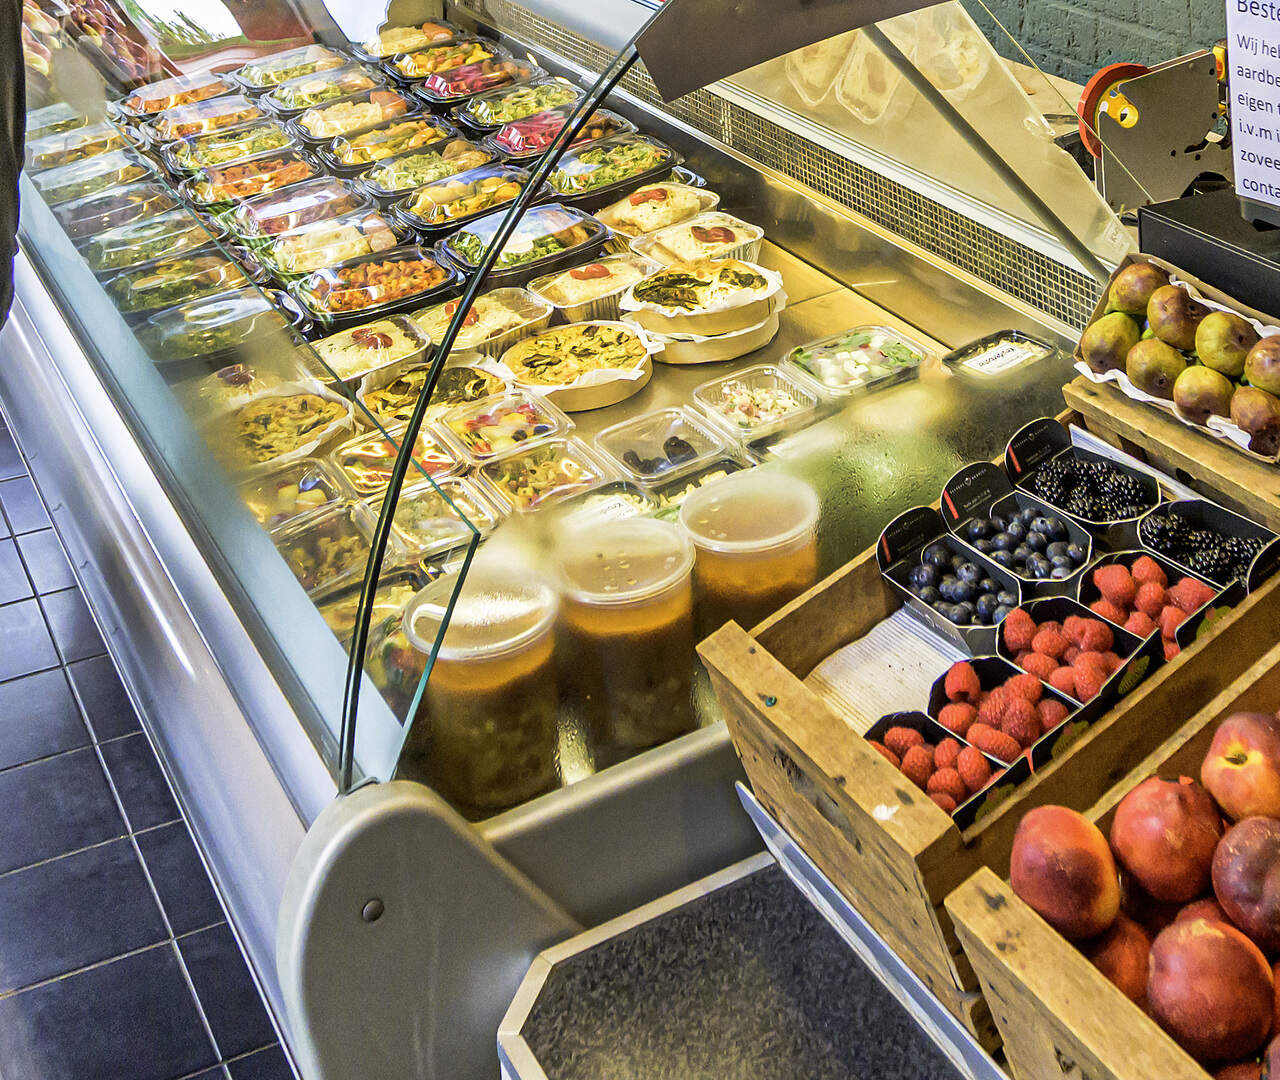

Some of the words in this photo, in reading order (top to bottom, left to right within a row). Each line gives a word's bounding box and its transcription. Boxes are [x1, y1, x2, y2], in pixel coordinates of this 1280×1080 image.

[1236, 33, 1260, 57] Wij
[1237, 91, 1274, 116] eigen
[1238, 118, 1273, 141] i.v.m
